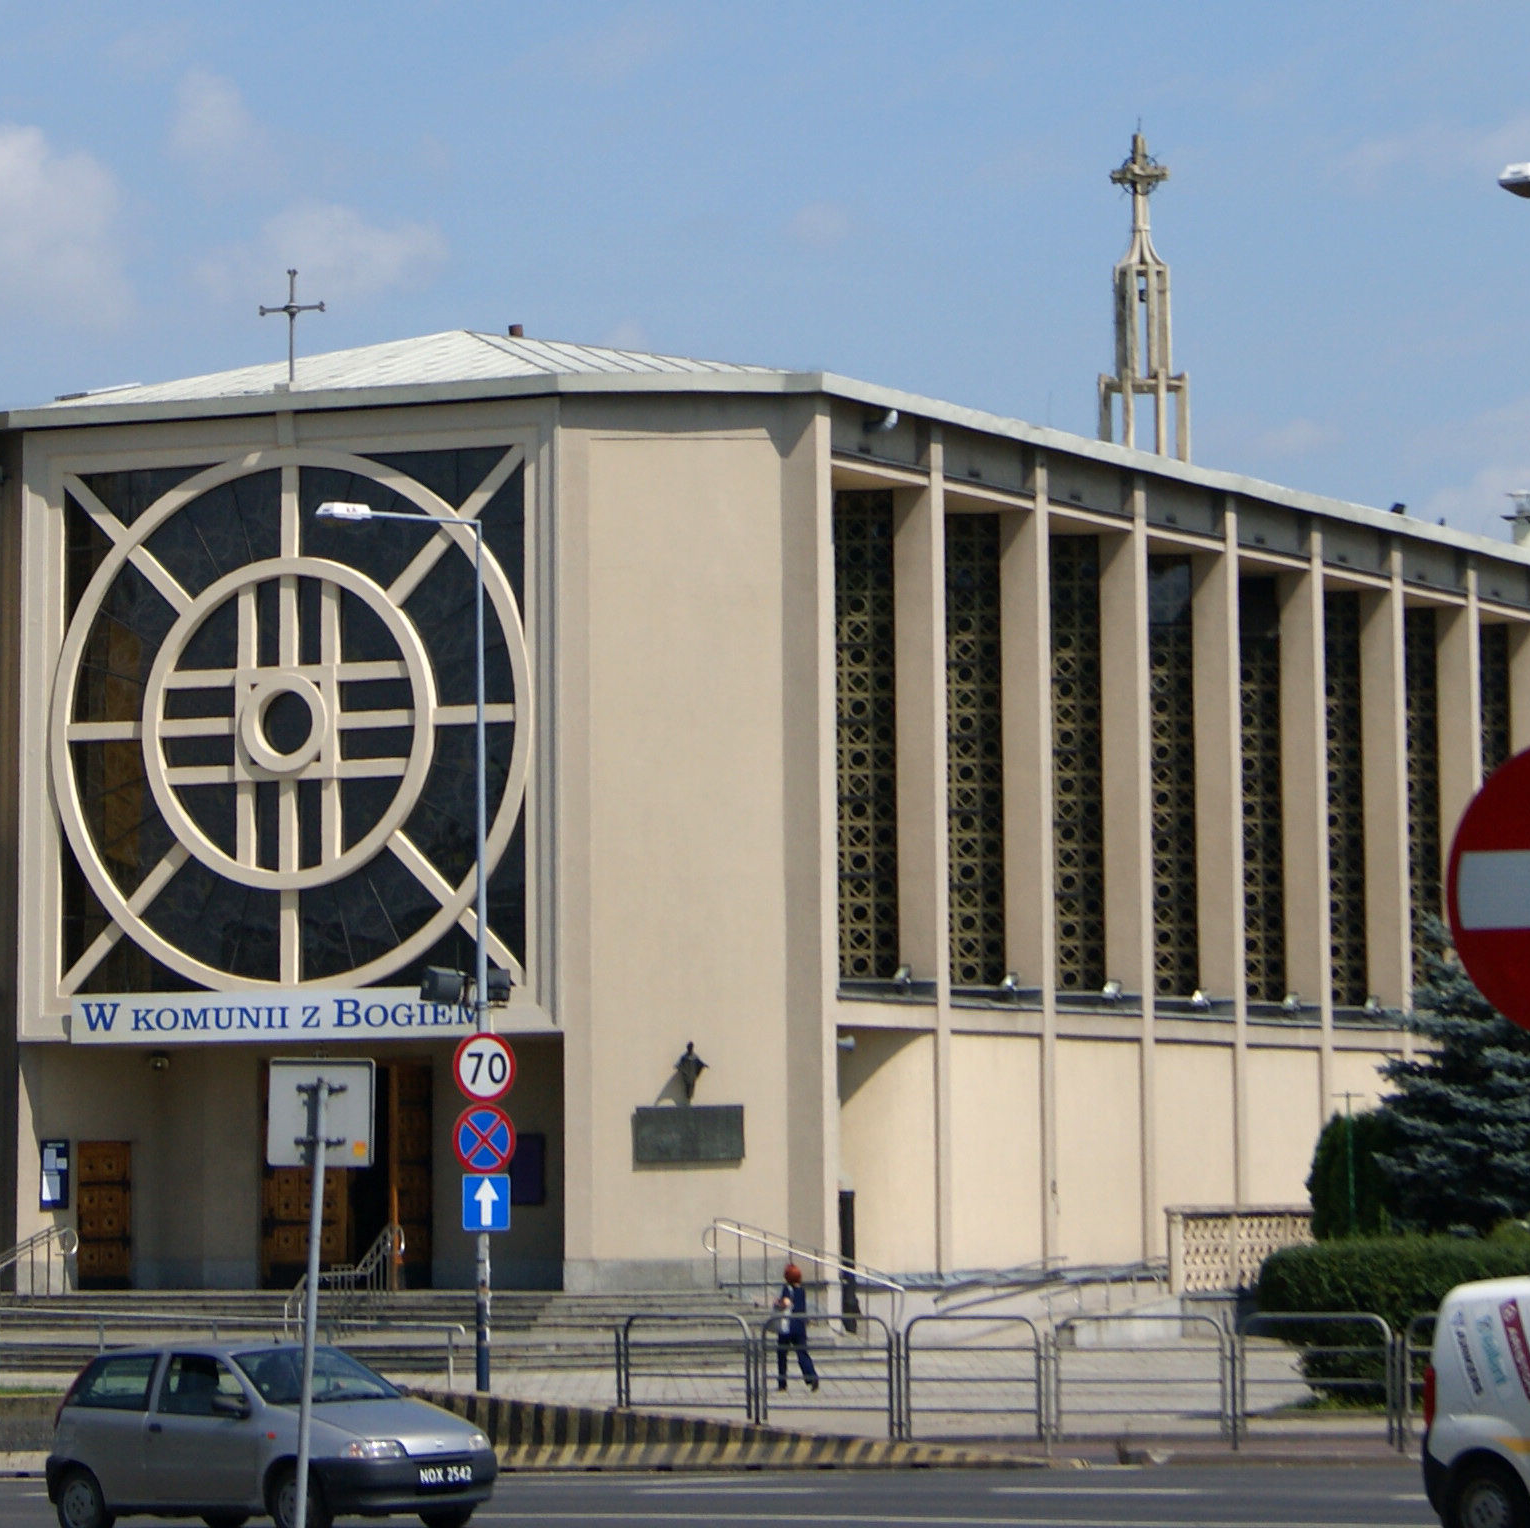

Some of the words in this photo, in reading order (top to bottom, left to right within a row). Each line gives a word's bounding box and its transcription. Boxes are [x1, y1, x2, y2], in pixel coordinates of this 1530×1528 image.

[81, 1003, 121, 1032] W
[130, 1006, 290, 1032] KOMUNII
[301, 1005, 322, 1029] Z
[467, 1052, 507, 1084] 70
[419, 1466, 445, 1483] NOX
